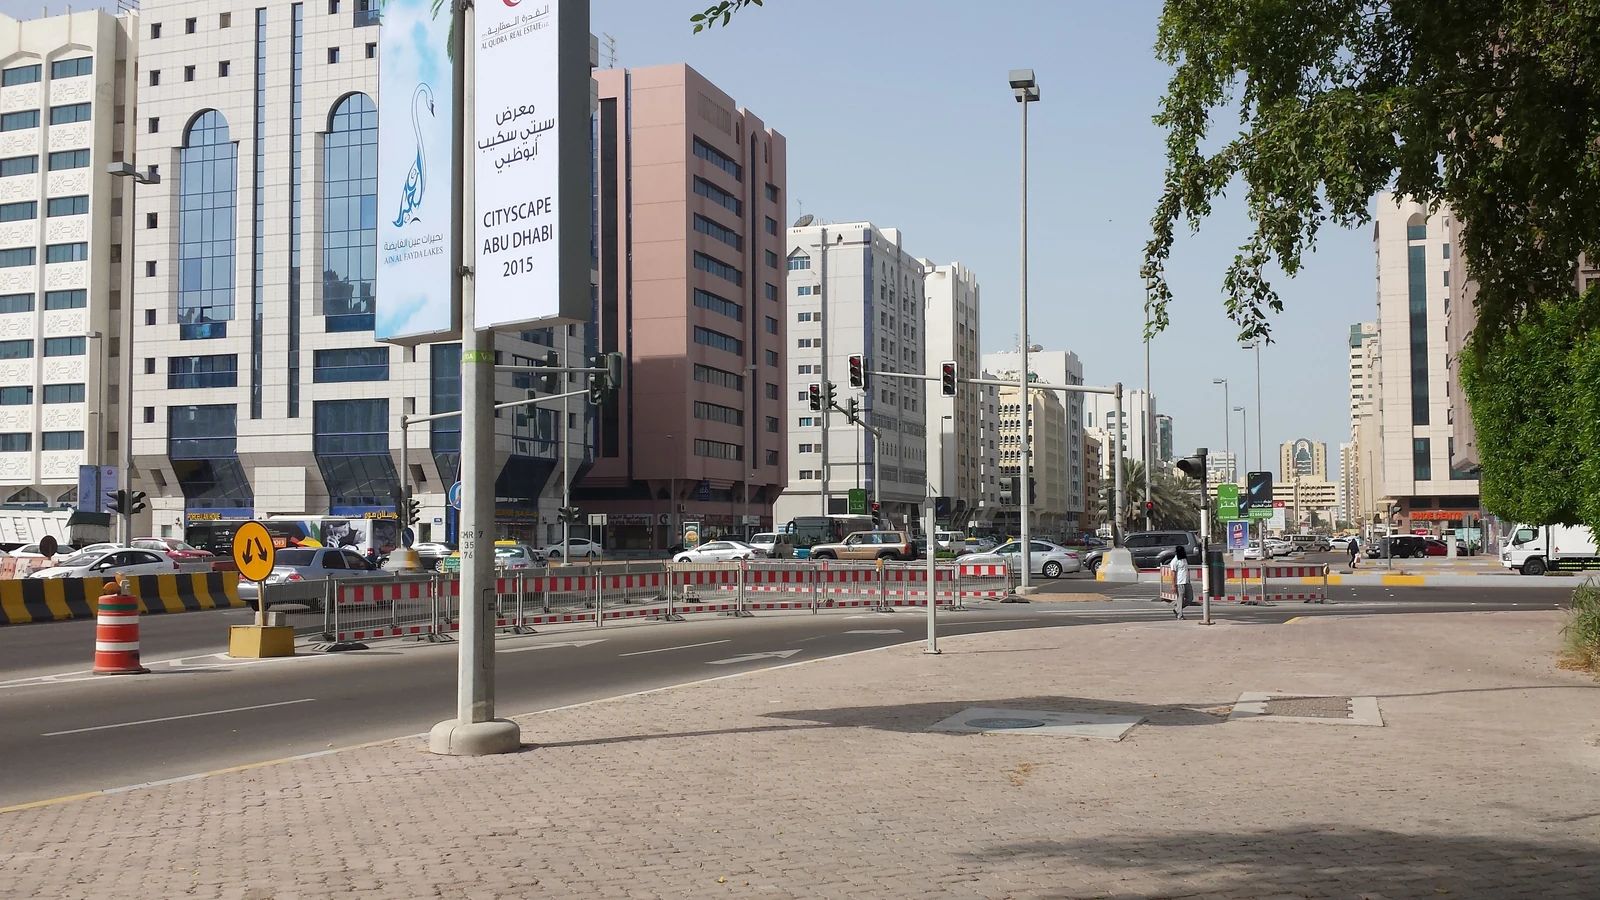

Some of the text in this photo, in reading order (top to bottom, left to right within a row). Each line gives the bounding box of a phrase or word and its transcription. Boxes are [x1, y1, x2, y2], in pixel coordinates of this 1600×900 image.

[480, 42, 487, 50] AL
[488, 35, 508, 48] QUDRA
[509, 29, 522, 41] REAL
[523, 22, 541, 36] ESTATE
[496, 104, 535, 126] معرض
[478, 117, 555, 153] سيتي سكيب
[495, 138, 538, 174] أبوظبي
[483, 196, 552, 228] CITYSCAPE
[483, 223, 553, 255] ABU DHABI
[384, 246, 444, 265] AIN AL FAYDA LAKES
[503, 256, 533, 277] 2015
